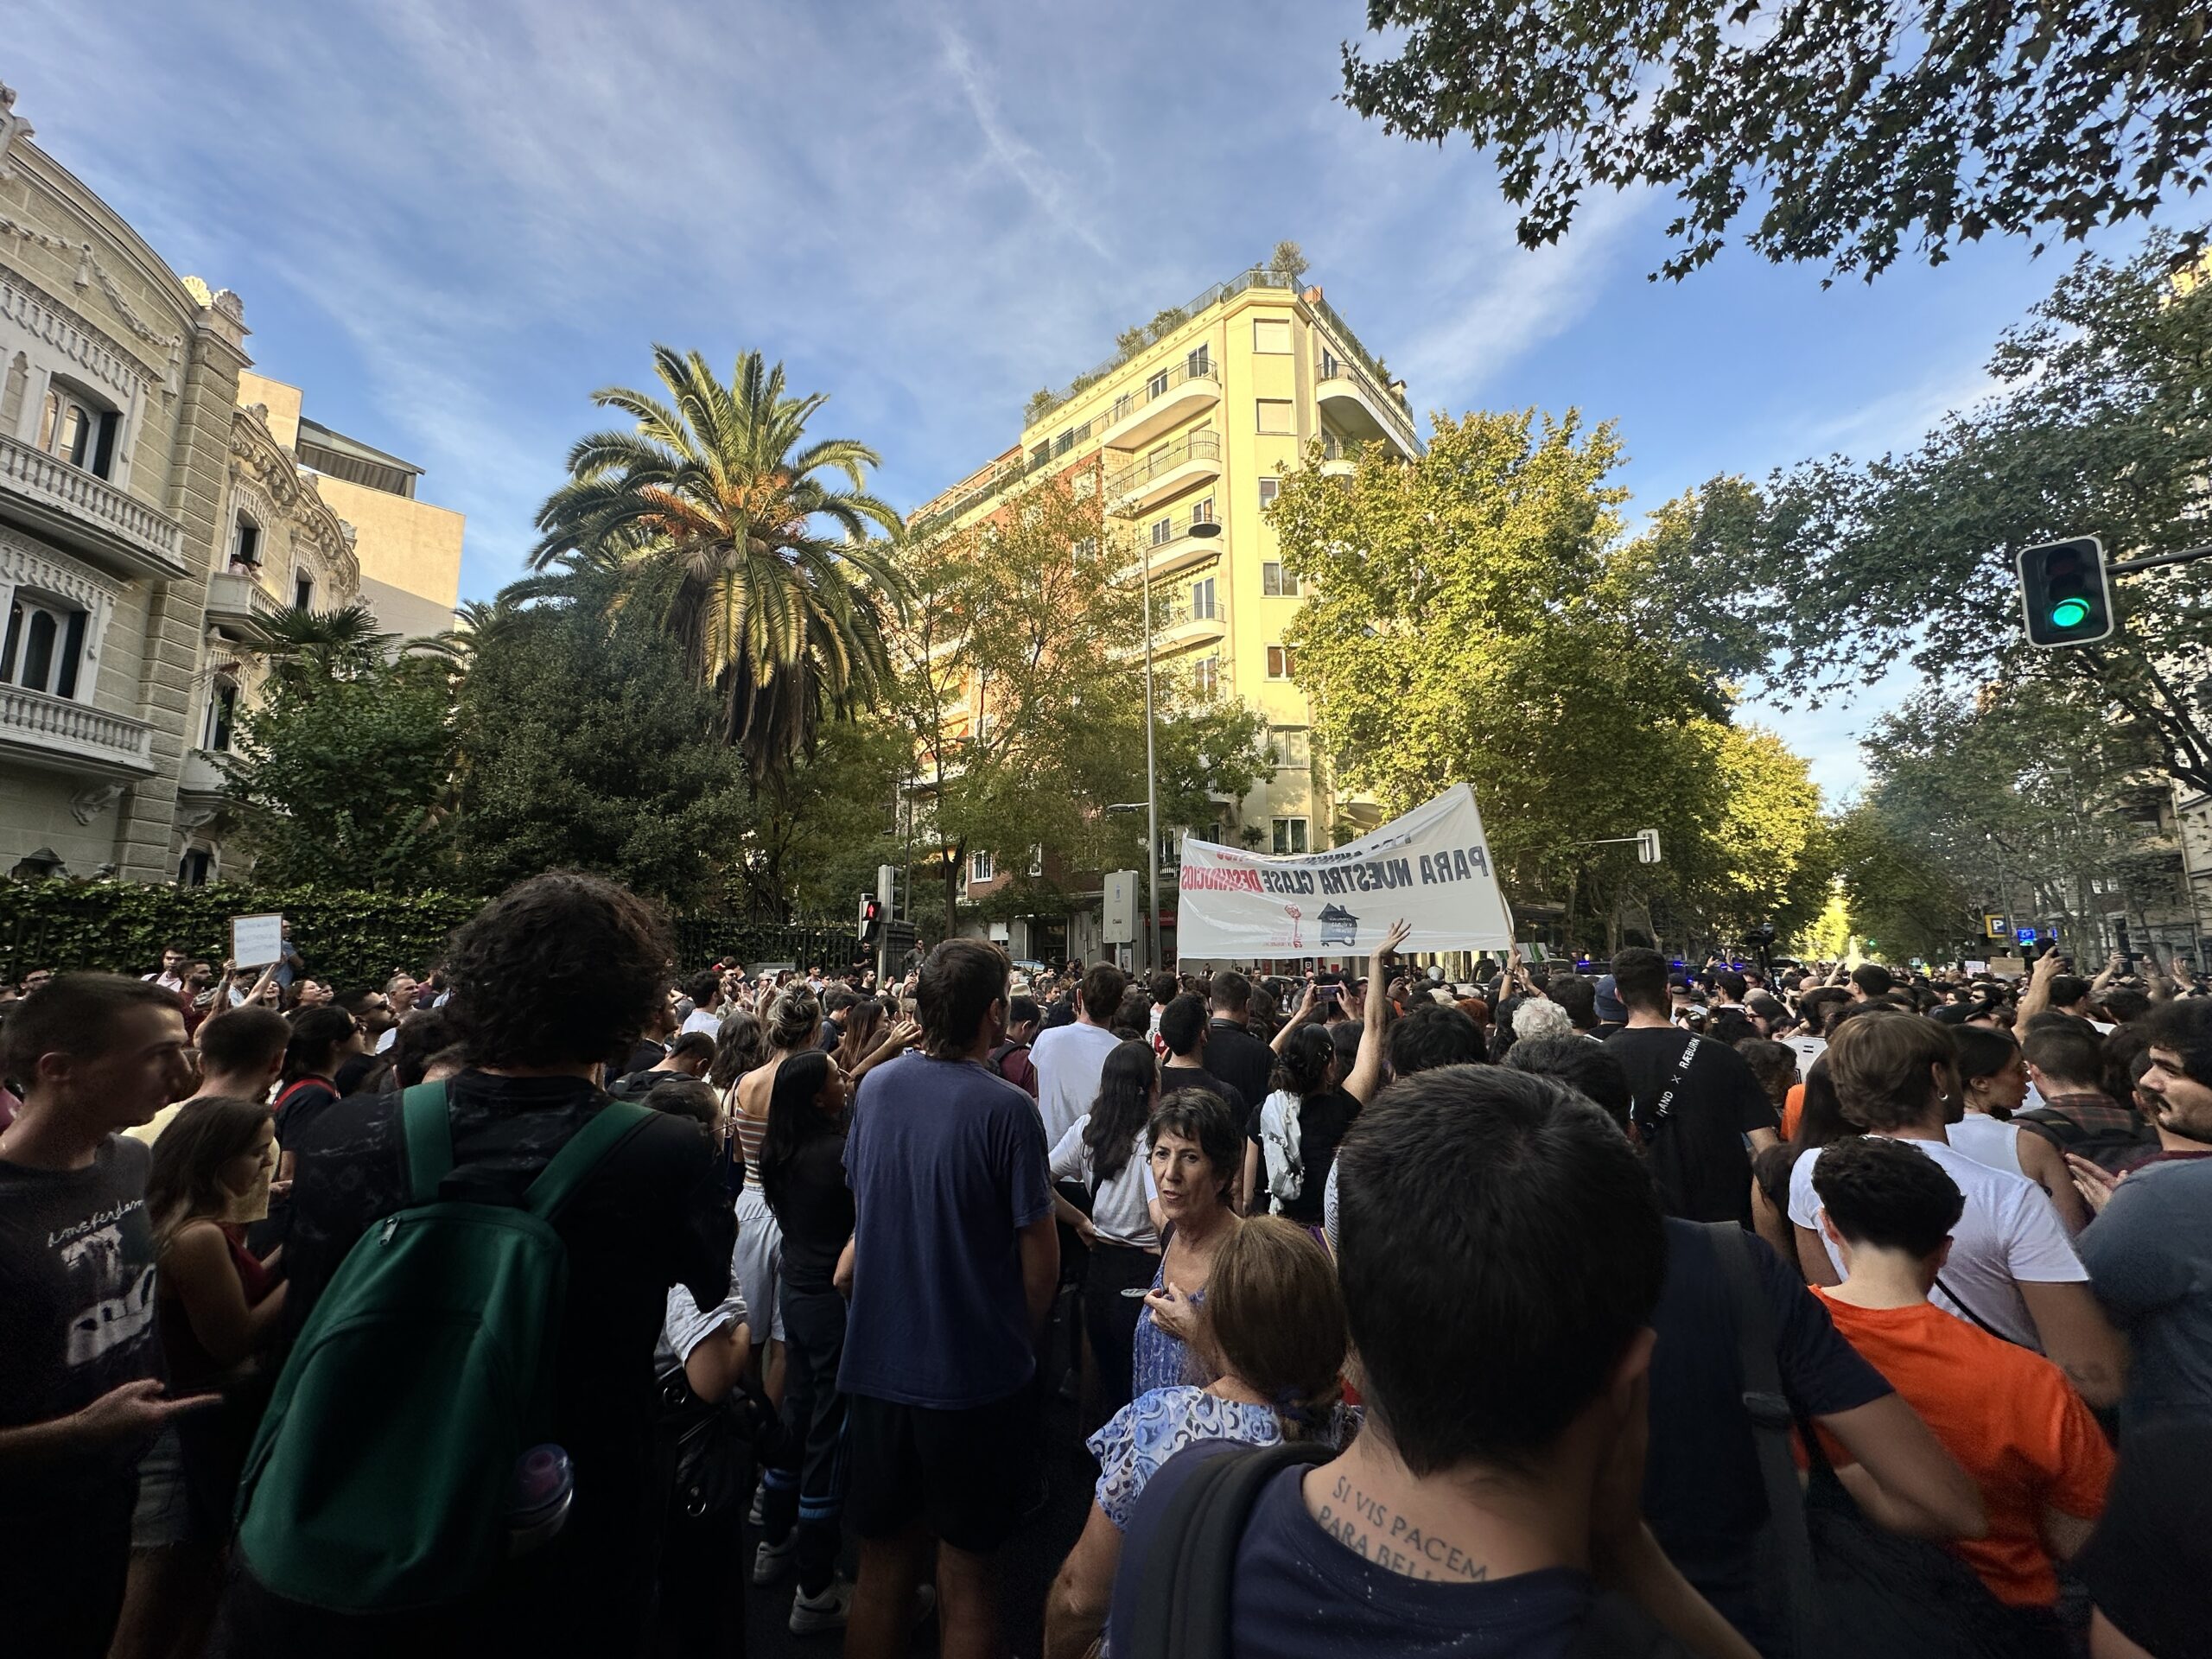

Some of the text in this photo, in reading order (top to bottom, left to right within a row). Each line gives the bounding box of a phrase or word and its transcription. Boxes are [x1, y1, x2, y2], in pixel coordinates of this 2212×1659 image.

[1993, 919, 2004, 931] P
[1318, 1505, 1369, 1558] PARA
[1332, 1475, 1487, 1582] SI VIS PACEM
